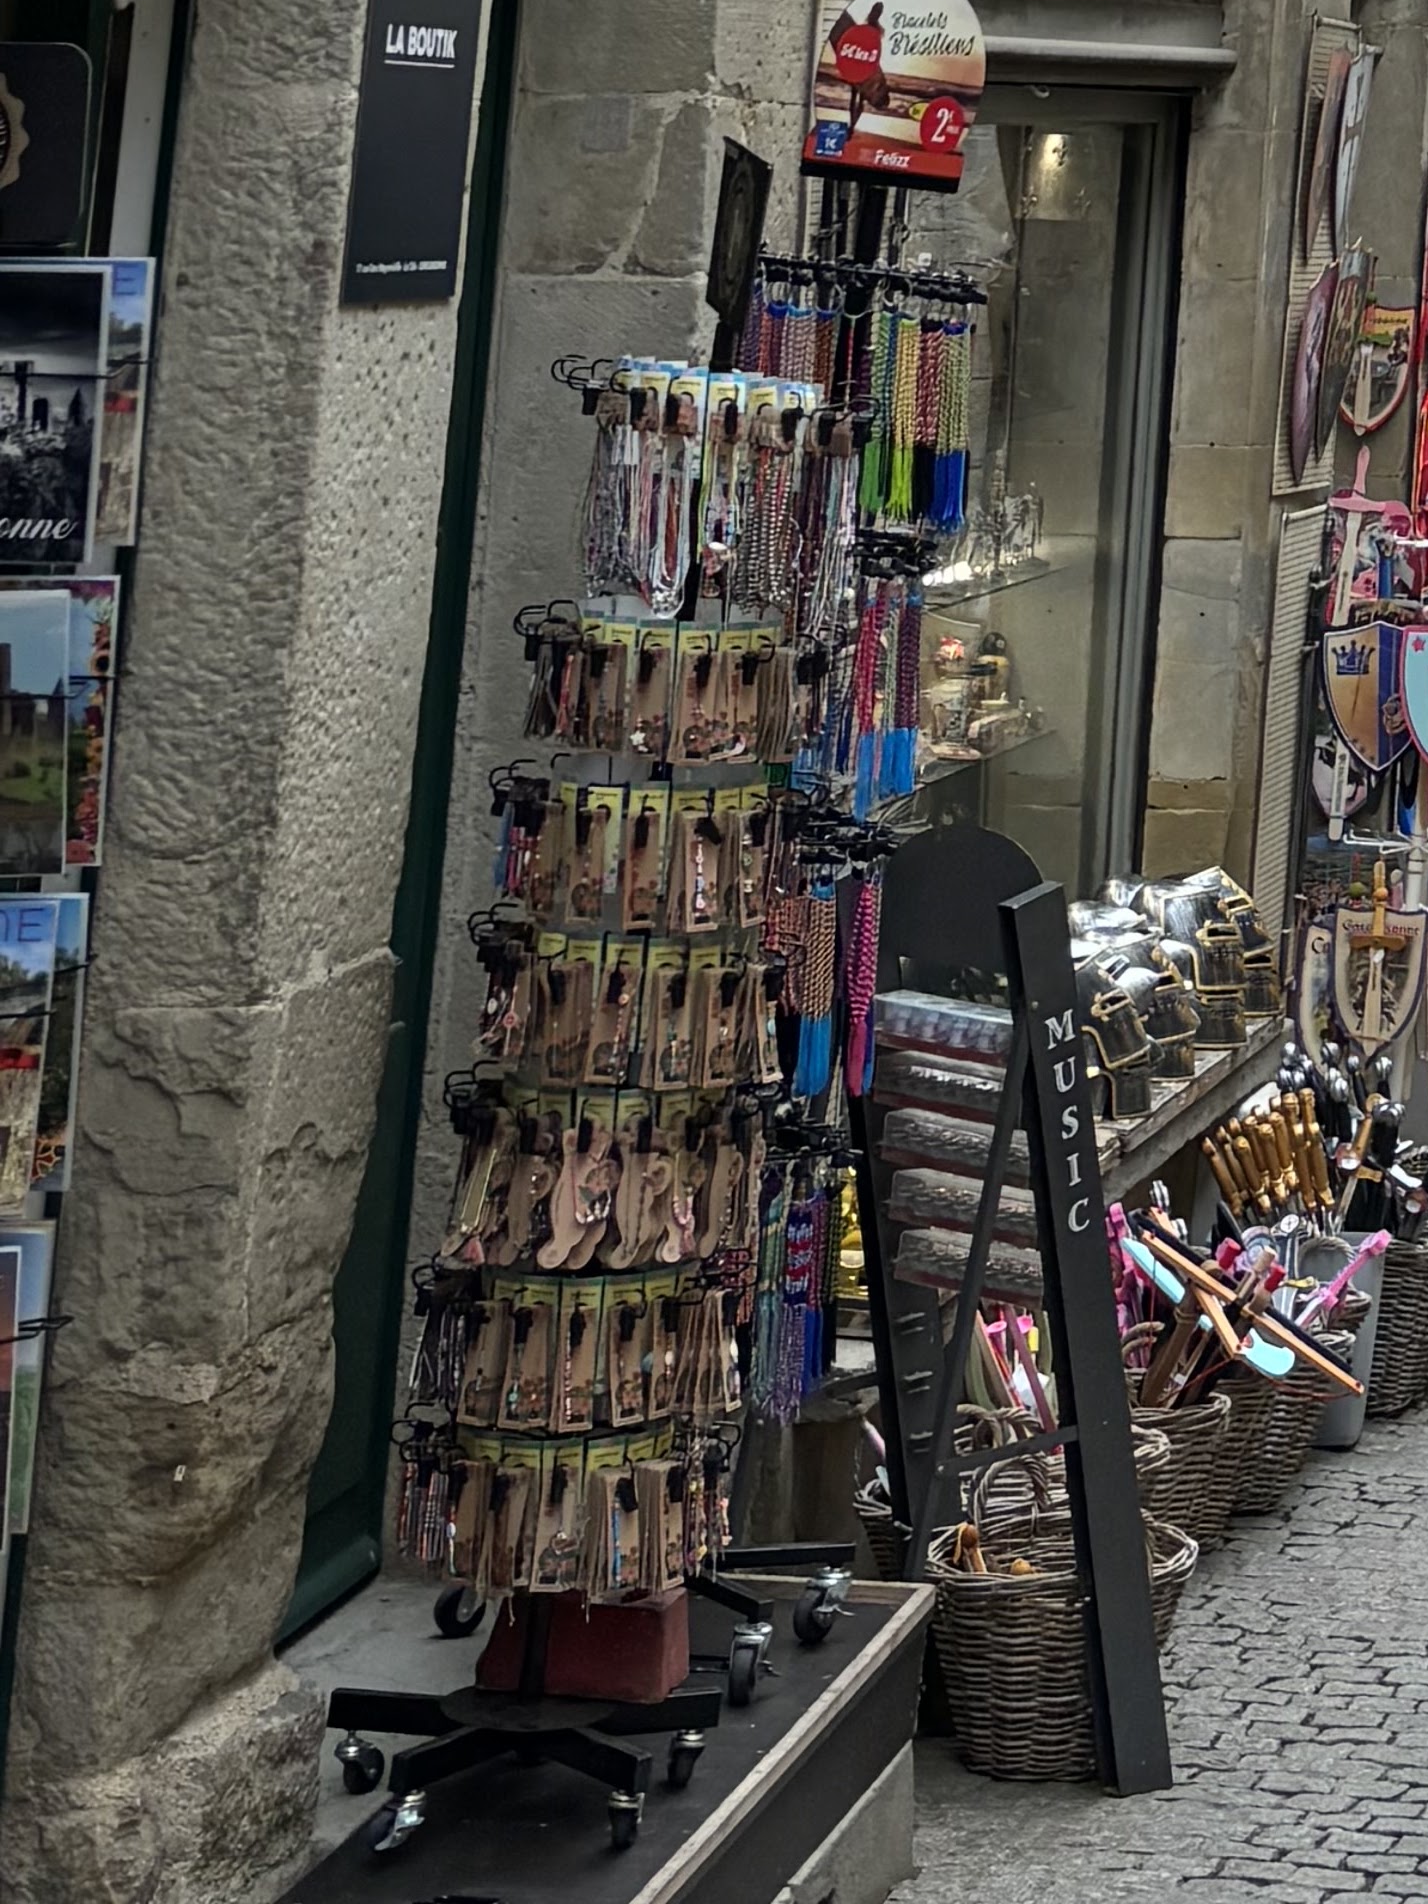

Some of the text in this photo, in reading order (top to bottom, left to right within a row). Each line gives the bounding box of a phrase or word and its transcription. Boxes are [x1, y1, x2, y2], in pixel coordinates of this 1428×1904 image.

[386, 23, 458, 59] LA BOUTIK
[1044, 1008, 1091, 1233] MUSIC
